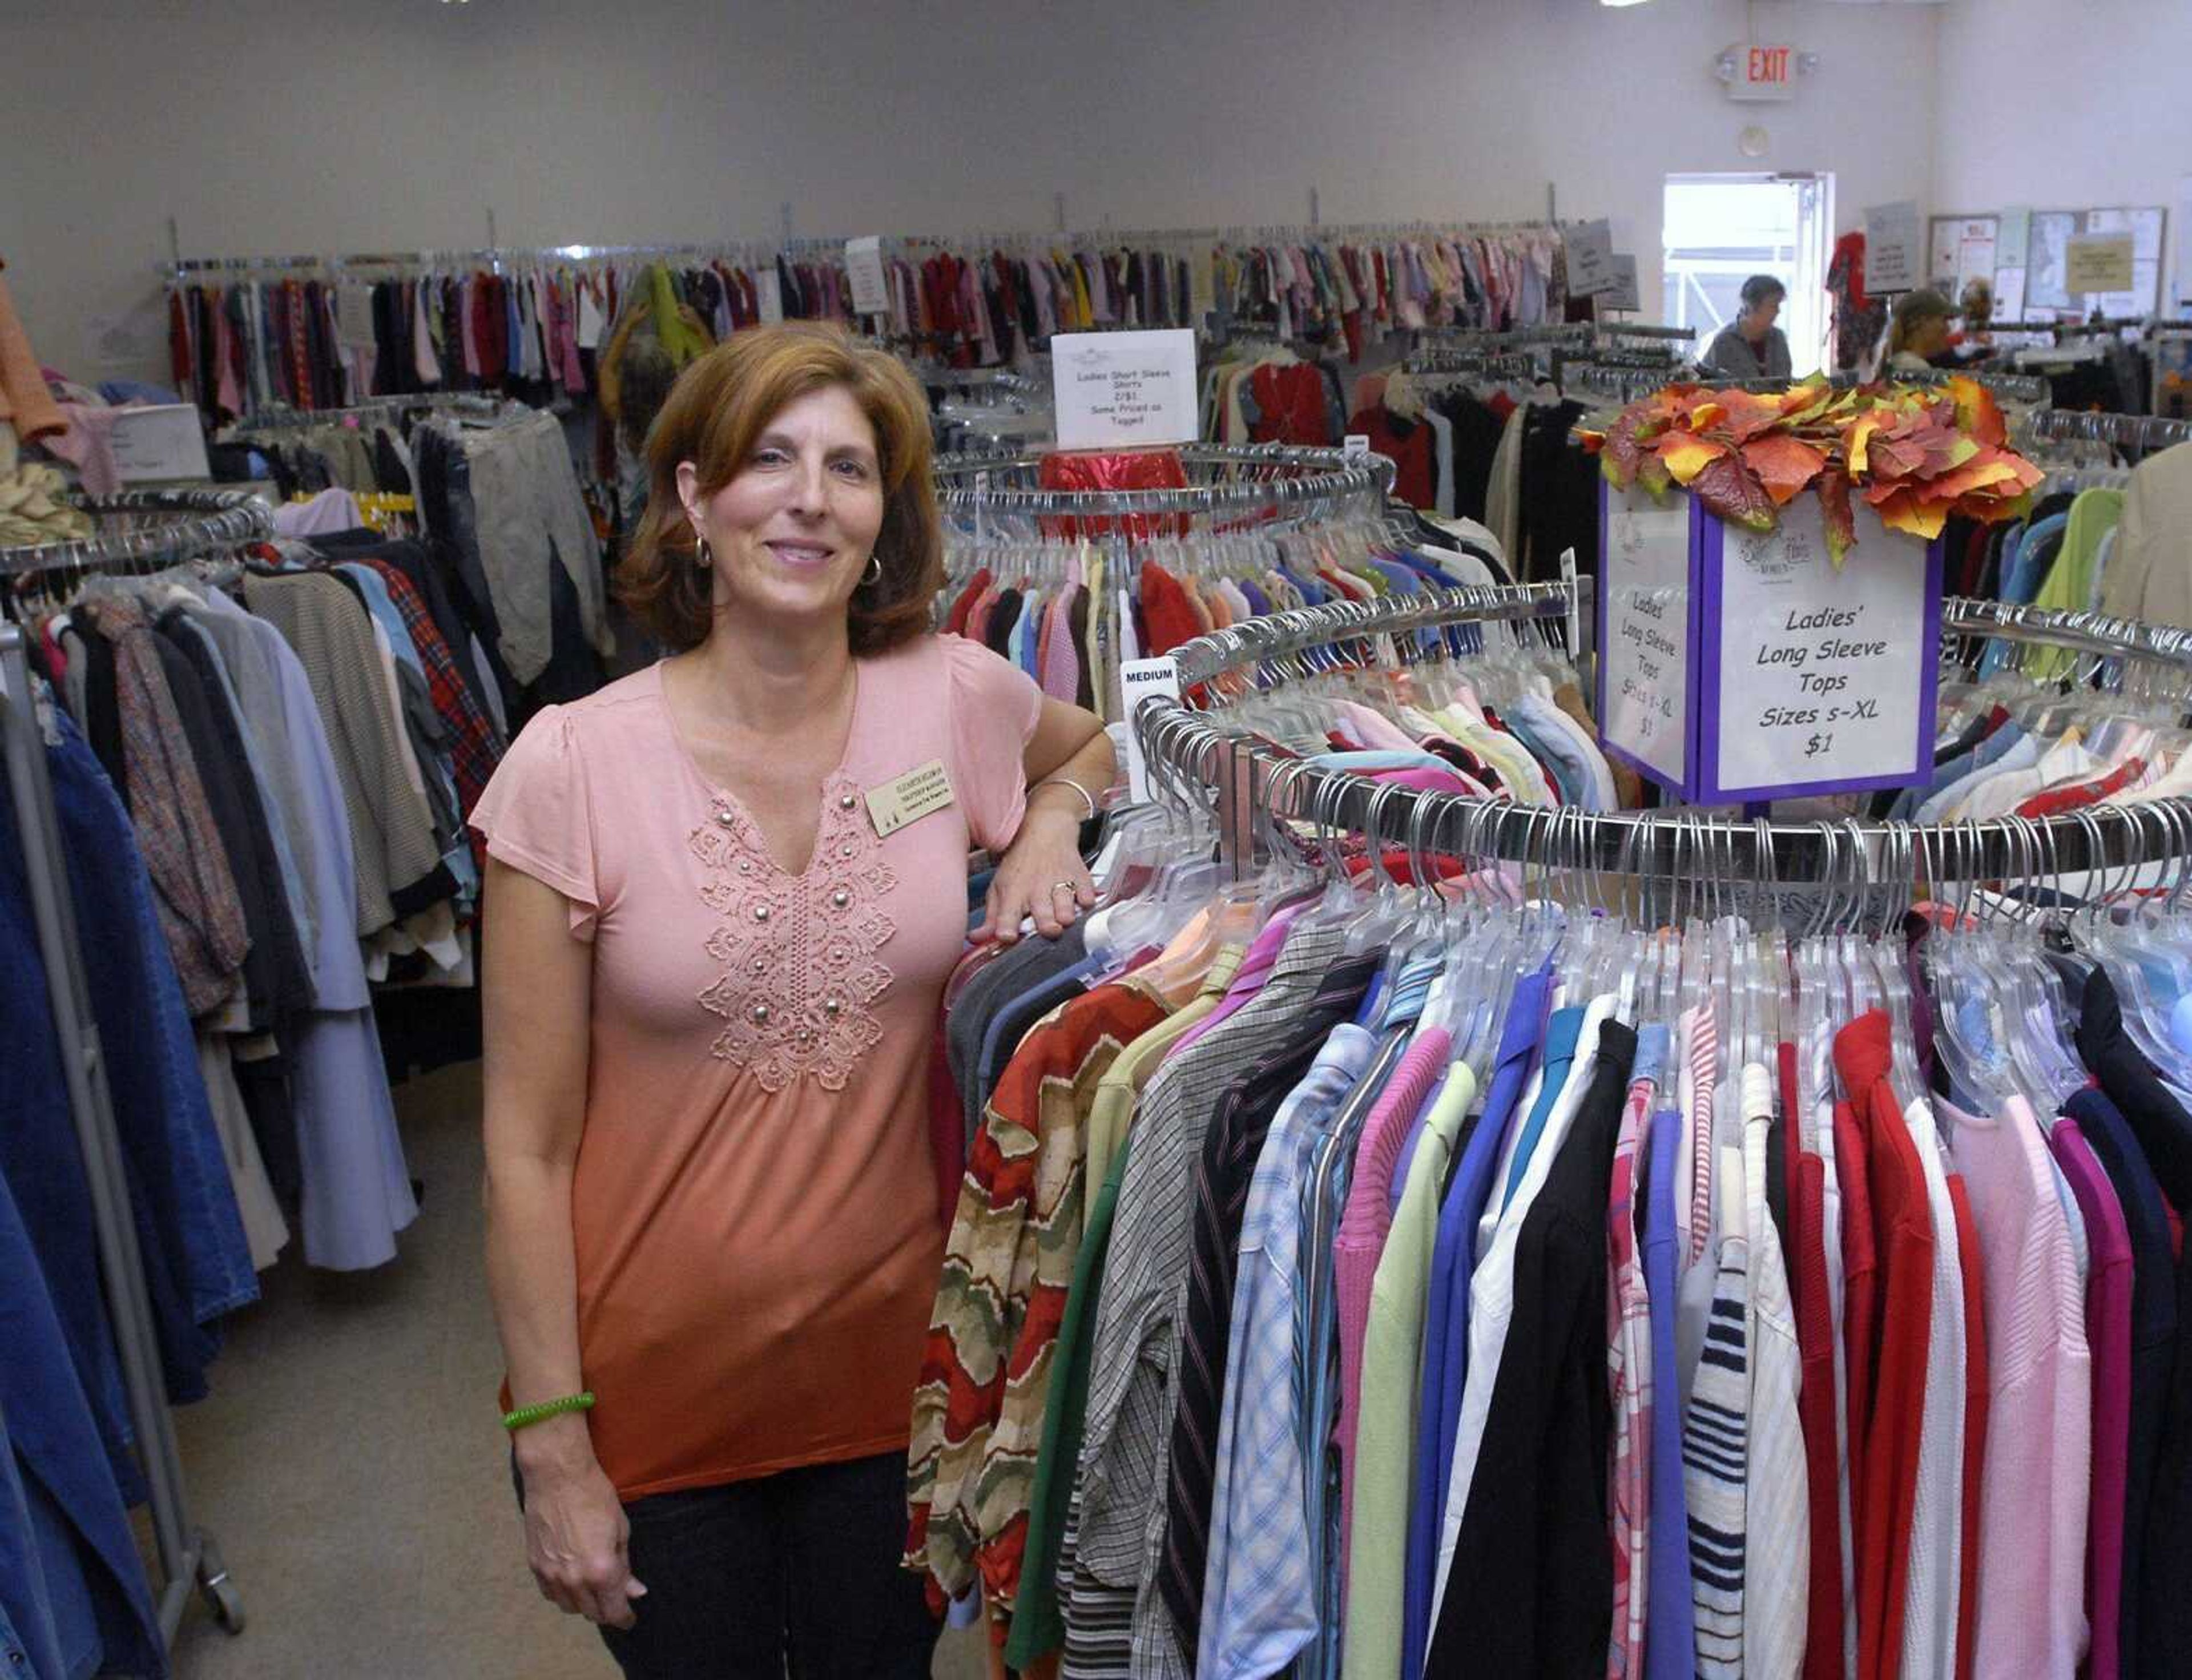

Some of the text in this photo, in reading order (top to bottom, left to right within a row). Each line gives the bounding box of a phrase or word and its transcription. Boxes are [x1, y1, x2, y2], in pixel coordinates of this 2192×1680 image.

[1748, 46, 1790, 83] EXIT
[1077, 372, 1107, 381] Ladies
[1111, 371, 1137, 380] Short
[1091, 406, 1114, 414] Some
[1119, 403, 1147, 412] Priced
[1111, 416, 1144, 426] Tagged
[1786, 605, 1863, 631] Ladies'
[1621, 618, 1676, 656] Long Sleeve
[1757, 639, 1887, 667] Long Sleeve
[1126, 669, 1172, 683] MEDIUM
[1638, 654, 1661, 680] Tops
[1622, 678, 1647, 703] Sizes
[1800, 673, 1848, 696] Tops
[1759, 699, 1879, 727] Sizes s-XL
[1805, 734, 1833, 758] $1
